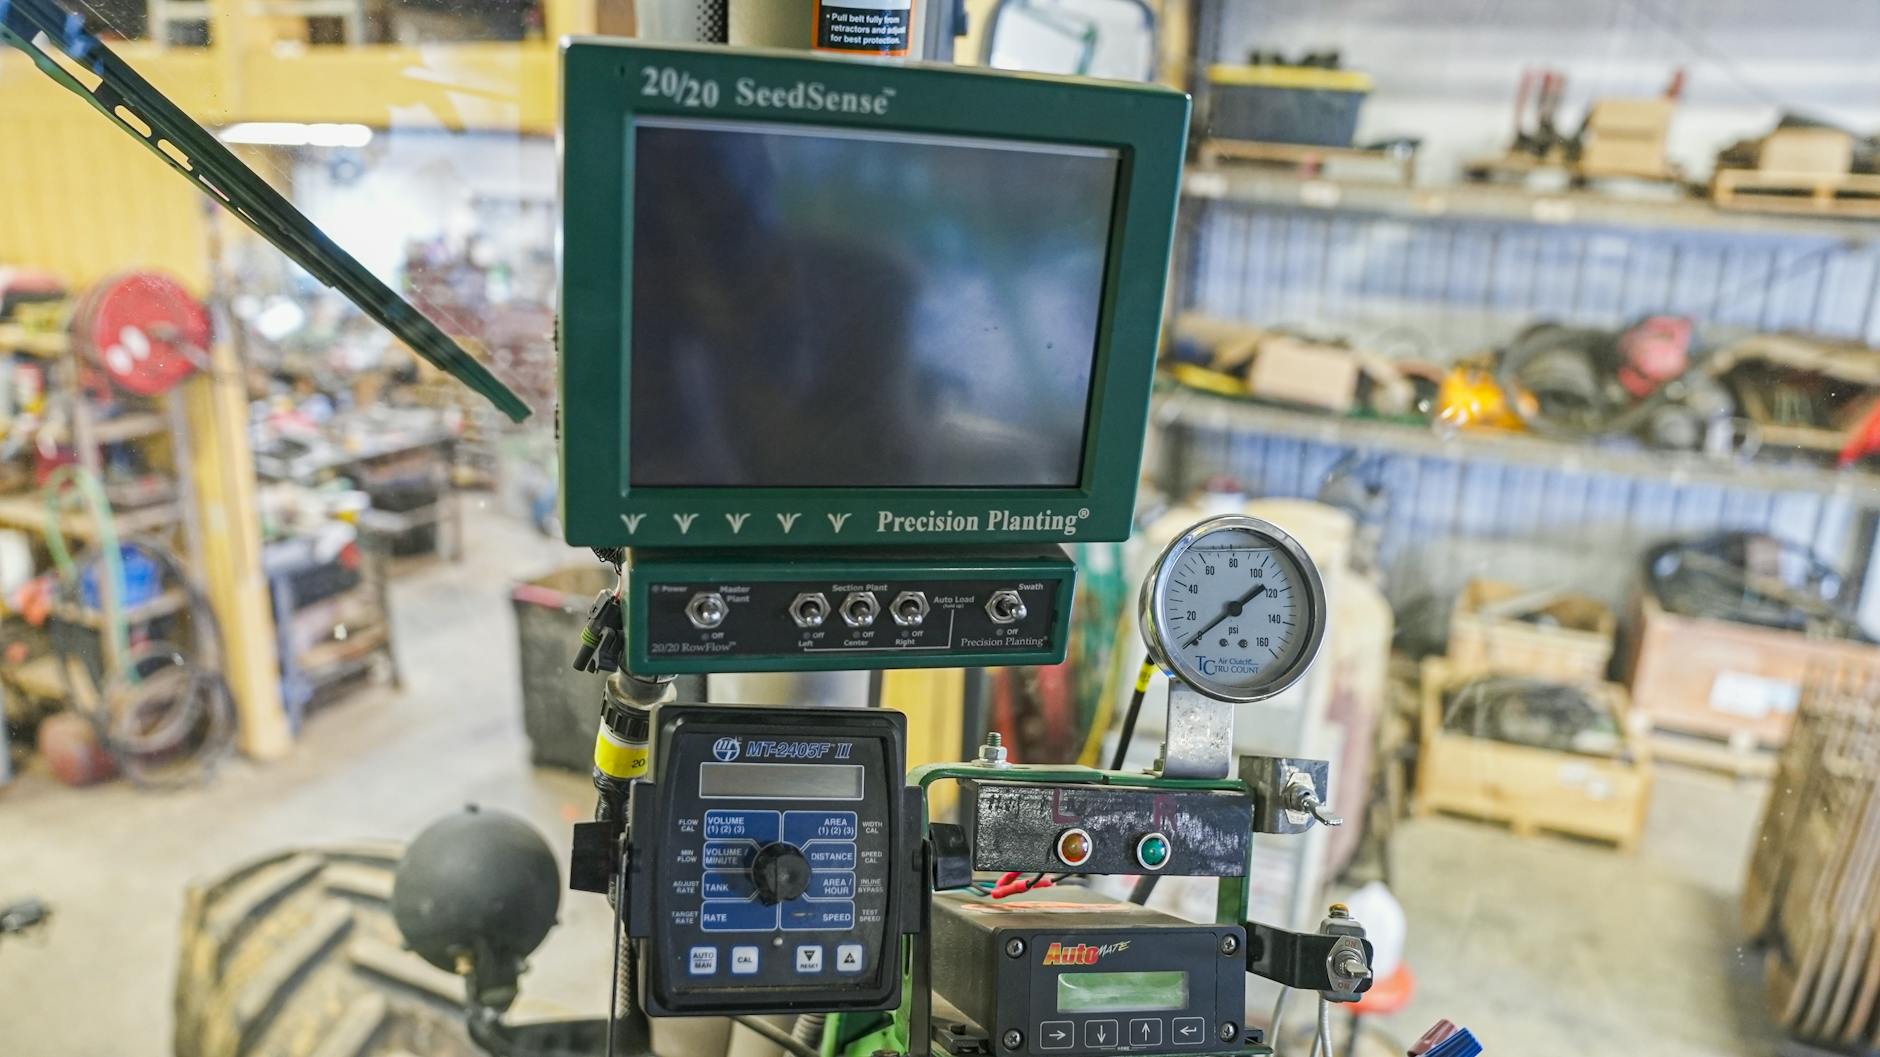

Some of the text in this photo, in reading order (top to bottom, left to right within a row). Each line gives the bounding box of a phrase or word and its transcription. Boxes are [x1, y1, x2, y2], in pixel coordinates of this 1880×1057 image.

[831, 13, 848, 21] Pull
[866, 15, 883, 25] fully
[831, 24, 870, 34] retractors
[871, 26, 886, 34] and
[830, 34, 842, 42] for
[844, 34, 861, 43] best
[641, 65, 720, 108] 20/20
[877, 510, 979, 533] Precision
[1229, 558, 1238, 568] 80
[1205, 565, 1215, 576] 60
[1250, 568, 1263, 578] 100
[720, 585, 751, 593] Master
[832, 583, 888, 592] Section Plant
[1018, 583, 1044, 591] Swath
[1189, 585, 1198, 594] 40
[1265, 588, 1278, 599] 120
[933, 595, 975, 604] Auto Load
[1186, 610, 1196, 621] 20
[1268, 614, 1281, 624] 140
[1228, 625, 1239, 636] psi
[895, 638, 915, 648] Right
[961, 638, 1002, 647] Precision
[1256, 637, 1269, 647] 160
[651, 643, 679, 652] 20/20
[1231, 665, 1259, 674] COUNT
[631, 758, 646, 769] 20
[707, 816, 745, 825] VOLUME
[824, 818, 848, 826] AREA
[707, 825, 745, 835] (1) (2) (3)
[818, 826, 854, 836] (1) (2) (3)
[706, 848, 742, 856] VOLUME
[811, 852, 853, 861] DISTANCE
[705, 856, 738, 864] MINUTE
[823, 878, 847, 887] AREA
[705, 884, 729, 892] TANK
[824, 886, 849, 895] HOUR
[704, 913, 727, 922] RATE
[823, 913, 851, 921] SPEED
